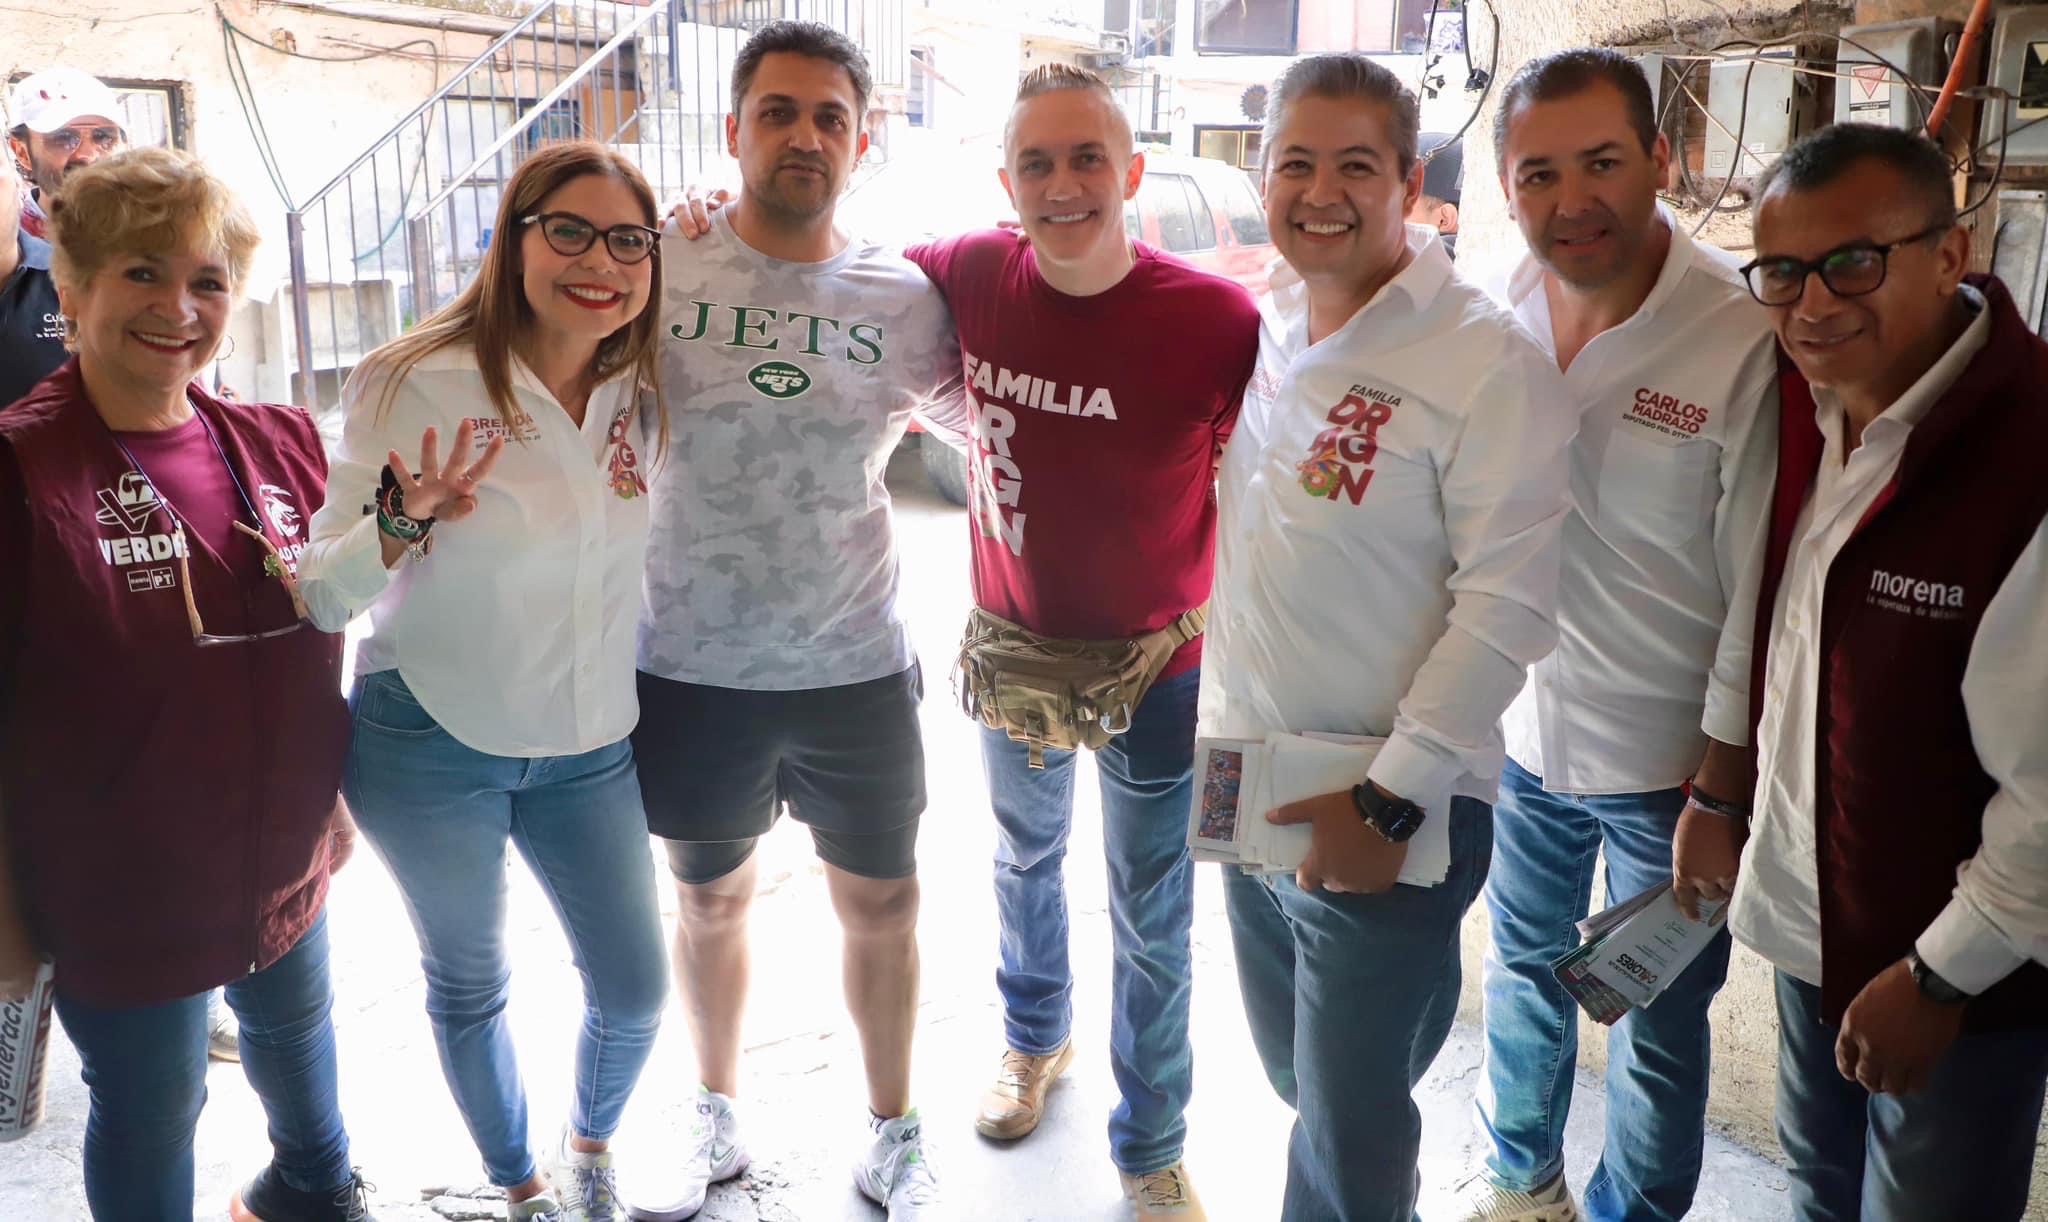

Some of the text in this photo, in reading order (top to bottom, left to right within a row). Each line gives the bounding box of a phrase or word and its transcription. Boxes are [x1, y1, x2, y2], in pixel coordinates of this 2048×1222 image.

[670, 300, 884, 365] JETS
[754, 374, 804, 388] JETS
[966, 352, 1119, 420] FAMILIA
[1349, 384, 1402, 407] FAMILIA
[1622, 412, 1657, 429] DIPUTADO
[1632, 402, 1700, 434] MADRAZO
[1635, 387, 1708, 424] CARLOS
[472, 413, 534, 431] BREDA
[98, 533, 191, 566] VERDE
[154, 574, 171, 586] PT
[1870, 569, 1964, 607] morena
